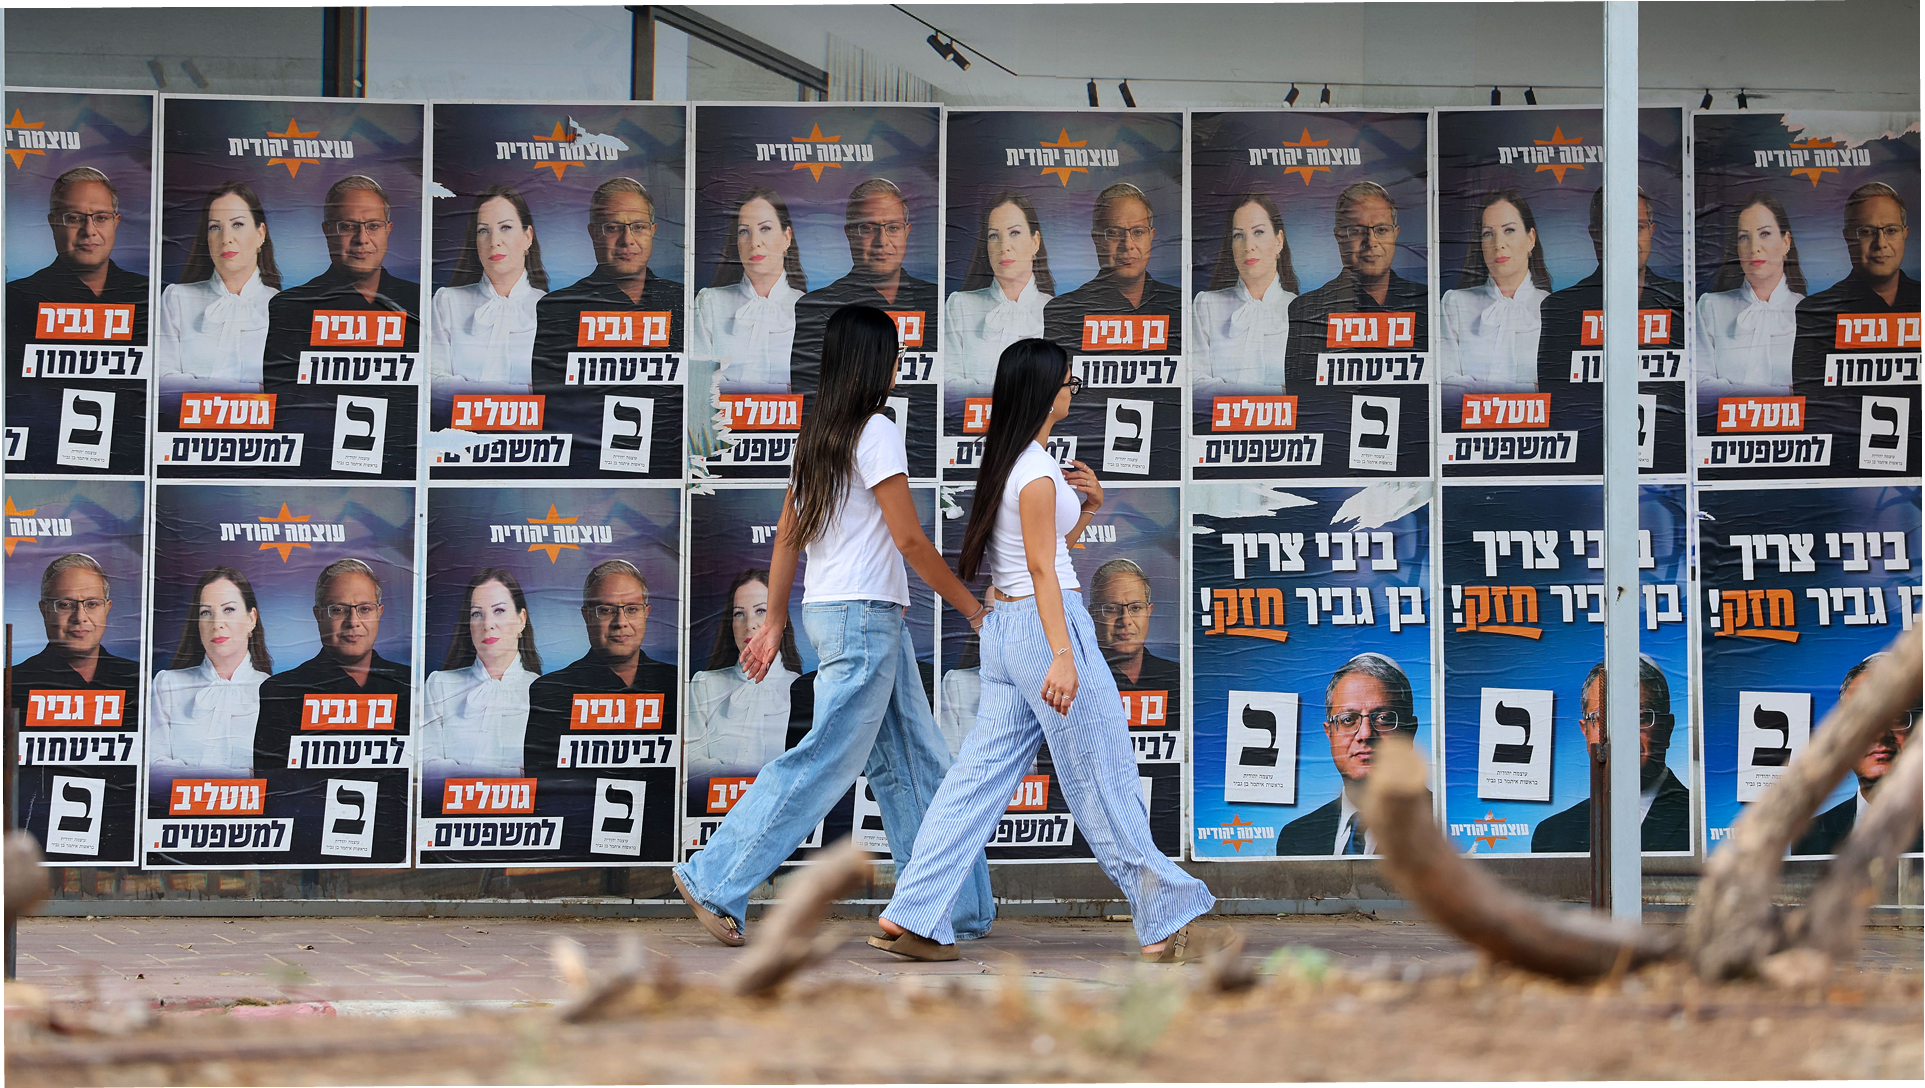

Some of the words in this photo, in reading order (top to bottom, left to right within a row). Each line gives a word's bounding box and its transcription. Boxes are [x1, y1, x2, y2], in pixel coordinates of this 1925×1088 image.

[18, 131, 80, 149] עוצמה
[228, 138, 288, 156] יהודית
[293, 140, 353, 158] עוצמה
[496, 142, 554, 159] יהודית
[756, 144, 812, 161] יהודית
[816, 144, 873, 161] עוצמה
[1006, 149, 1060, 165] יהודית
[1064, 149, 1119, 166] עוצמה
[1249, 148, 1302, 165] יהודית
[1306, 148, 1361, 165] עוצמה
[1498, 147, 1554, 163] יהודית
[1560, 145, 1603, 164] וצמה
[1754, 150, 1809, 167] יהודית
[1814, 147, 1870, 166] עוצמה
[40, 308, 93, 333] גביר
[104, 309, 129, 338] בן
[315, 316, 366, 340] גביר
[377, 316, 401, 345] בן
[582, 317, 632, 340] גביר
[643, 317, 666, 345] בן
[897, 316, 920, 343] בן
[1086, 321, 1133, 344] גביר
[1143, 321, 1165, 348] בן
[1330, 318, 1378, 341] גביר
[1388, 318, 1411, 346] בן
[1644, 315, 1667, 343] בן
[1839, 319, 1887, 342] גביר
[1897, 318, 1920, 346] בן
[26, 348, 143, 377] לביטחון.
[301, 354, 414, 383] לביטחון.
[569, 354, 679, 383] לביטחון.
[1081, 358, 1177, 388] לביטחון
[1320, 354, 1424, 383] לביטחון.
[1828, 358, 1918, 384] ביטחון.
[68, 395, 103, 445] ב
[184, 396, 269, 424] גוטליב
[455, 398, 538, 425] גוטליב
[1216, 400, 1291, 426] גוטליב
[1465, 397, 1545, 424] גוטליב
[1721, 400, 1799, 427] גוטליב
[342, 401, 376, 451] ב
[610, 402, 642, 450] ב
[1112, 404, 1143, 452] ב
[1358, 401, 1390, 449] ב
[1869, 402, 1899, 449] ב
[165, 435, 296, 462] למשפטים.
[1199, 435, 1316, 463] למשפטים.
[1449, 433, 1571, 460] למשפטים.
[1704, 436, 1825, 464] למשפטים.
[10, 518, 72, 536] עוצמה
[220, 524, 280, 541] יהודית
[285, 524, 345, 542] עוצמה
[490, 525, 548, 542] יהודית
[553, 526, 612, 543] עוצמה
[1222, 533, 1304, 579] צריך
[1315, 532, 1397, 570] ביבי
[1473, 531, 1559, 576] צריך
[1730, 534, 1815, 580] צריך
[1826, 532, 1909, 570] ביבי
[1201, 588, 1284, 639] חזק!
[1296, 587, 1374, 624] גביר
[1385, 587, 1425, 631] בן
[1452, 585, 1538, 636] חזק!
[1550, 585, 1604, 622] ביר
[1642, 585, 1682, 629] בן
[1709, 589, 1796, 639] חזק!
[1806, 587, 1887, 625] גביר
[31, 695, 84, 719] גביר
[94, 696, 120, 725] בן
[305, 699, 357, 723] גביר
[367, 699, 392, 728] בן
[574, 699, 625, 723] גביר
[635, 699, 659, 728] בן
[1141, 696, 1163, 724] בן
[1239, 704, 1279, 767] ב
[1492, 701, 1533, 764] ב
[1752, 704, 1792, 766] ב
[292, 737, 405, 766] לביטחון.
[561, 737, 672, 766] לביטחון.
[58, 782, 92, 832] ב
[174, 782, 259, 810] גוטליב
[332, 785, 365, 834] ב
[447, 782, 529, 809] גוטליב
[601, 784, 634, 833] ב
[154, 820, 286, 848] למשפטים.
[428, 819, 556, 846] למשפטים.
[1198, 827, 1234, 839] יהודית
[1237, 827, 1274, 839] עוצמה
[1450, 824, 1489, 837] יהודית
[1491, 824, 1530, 836] עוצמה
